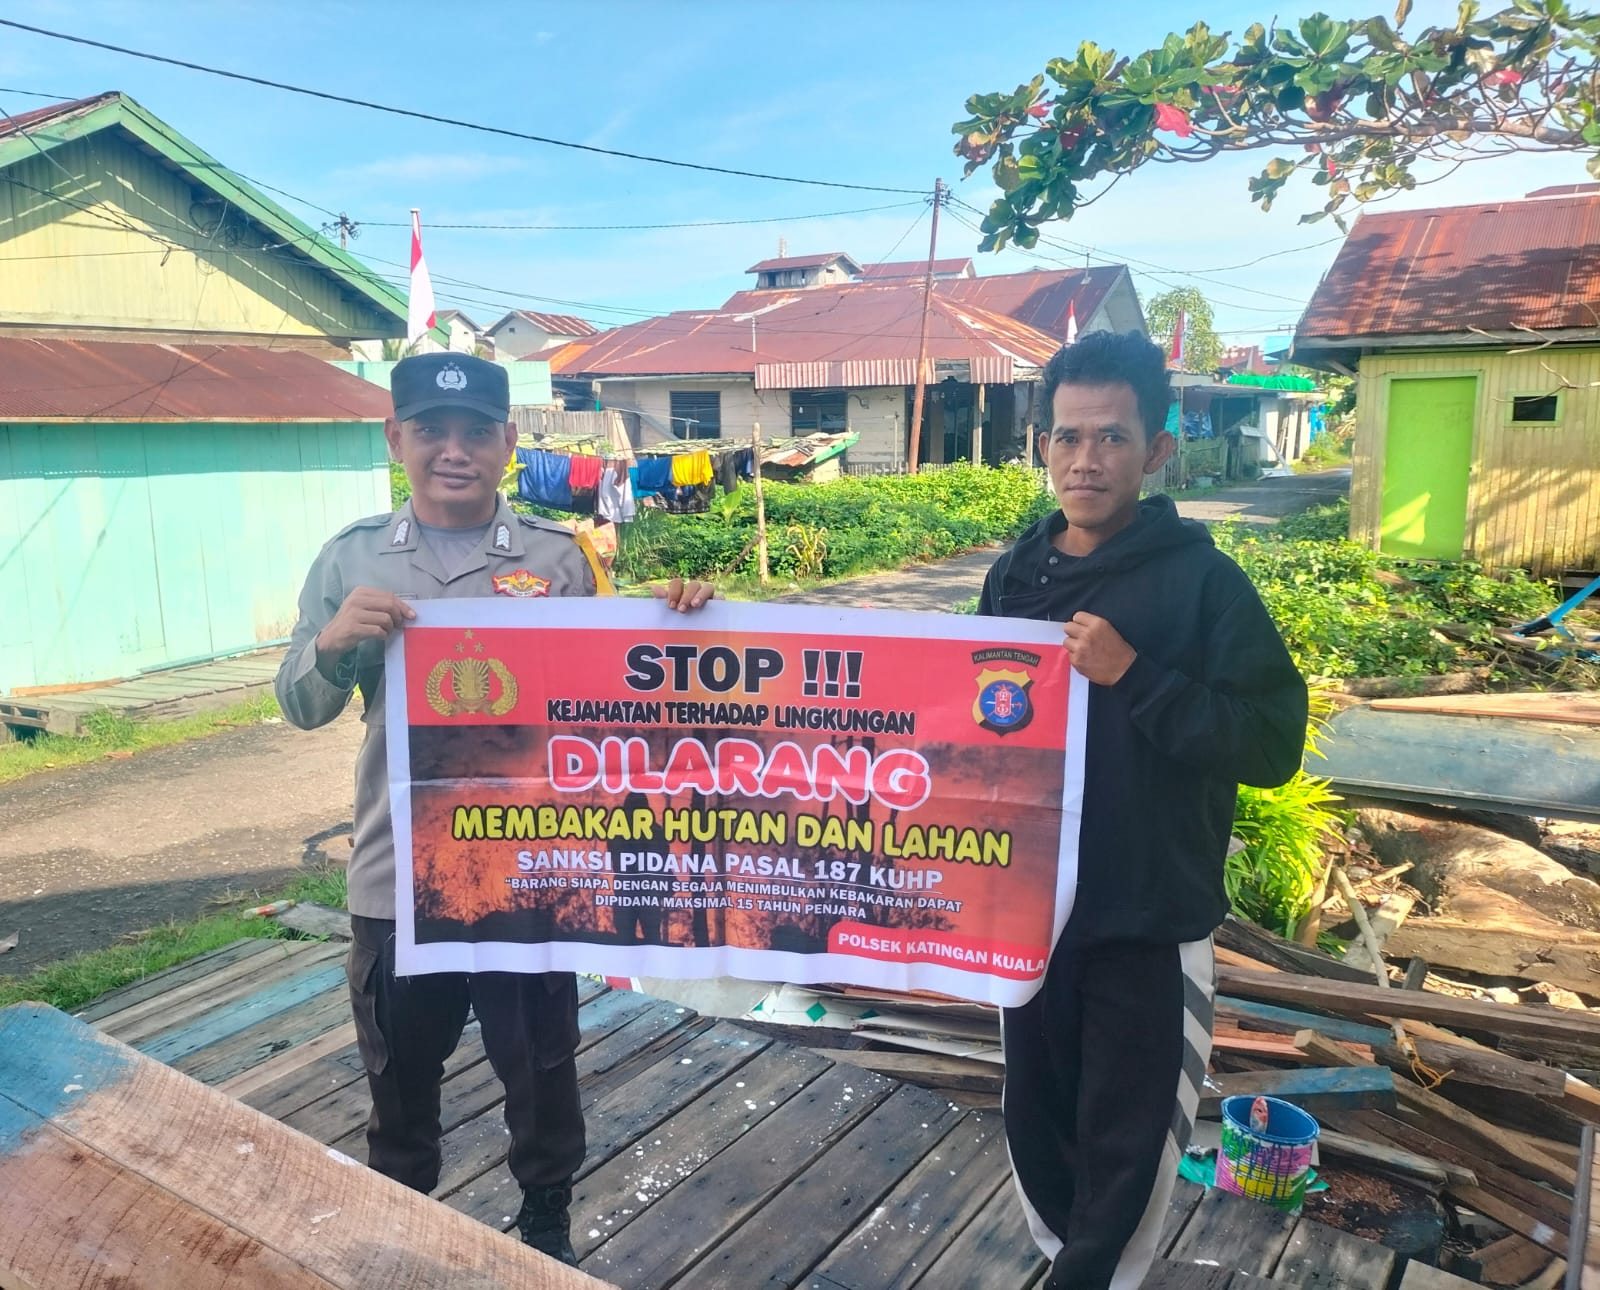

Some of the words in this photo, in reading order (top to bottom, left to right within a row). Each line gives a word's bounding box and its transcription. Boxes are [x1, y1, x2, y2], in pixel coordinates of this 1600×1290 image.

[623, 643, 785, 694] STOP
[801, 648, 864, 699] !!!
[973, 650, 1012, 662] KALIMANTAN
[547, 698, 662, 724] KEJAHATAN
[664, 700, 769, 726] TERHADAP
[774, 704, 916, 735] LINGKUNGAN
[547, 735, 932, 811] DILARANG
[451, 805, 655, 843] MEMBAKAR
[662, 807, 787, 846] HUTAN
[796, 812, 876, 853] DAN
[883, 822, 1012, 867] LAHAN
[517, 850, 612, 871] SANKSI
[620, 852, 717, 873] PIDANA
[725, 853, 805, 879] PASAL
[813, 860, 861, 882] 187
[869, 865, 943, 890] KUHP
[570, 878, 609, 890] SIAPA
[613, 880, 668, 892] DENGAN
[671, 881, 723, 892] SEGAJA
[726, 882, 826, 899] MENIMBULKAN
[829, 888, 913, 908] KEBAKARAN
[917, 897, 962, 913] DAPAT
[595, 894, 659, 907] DIPIDANA
[663, 897, 733, 908] MAKSIMAL
[737, 899, 754, 910] 15
[757, 899, 800, 913] TAHUN
[804, 904, 866, 919] PENJARA
[838, 932, 901, 954] POLSEK
[906, 941, 987, 965] KATINGAN
[992, 953, 1044, 972] KUALA
